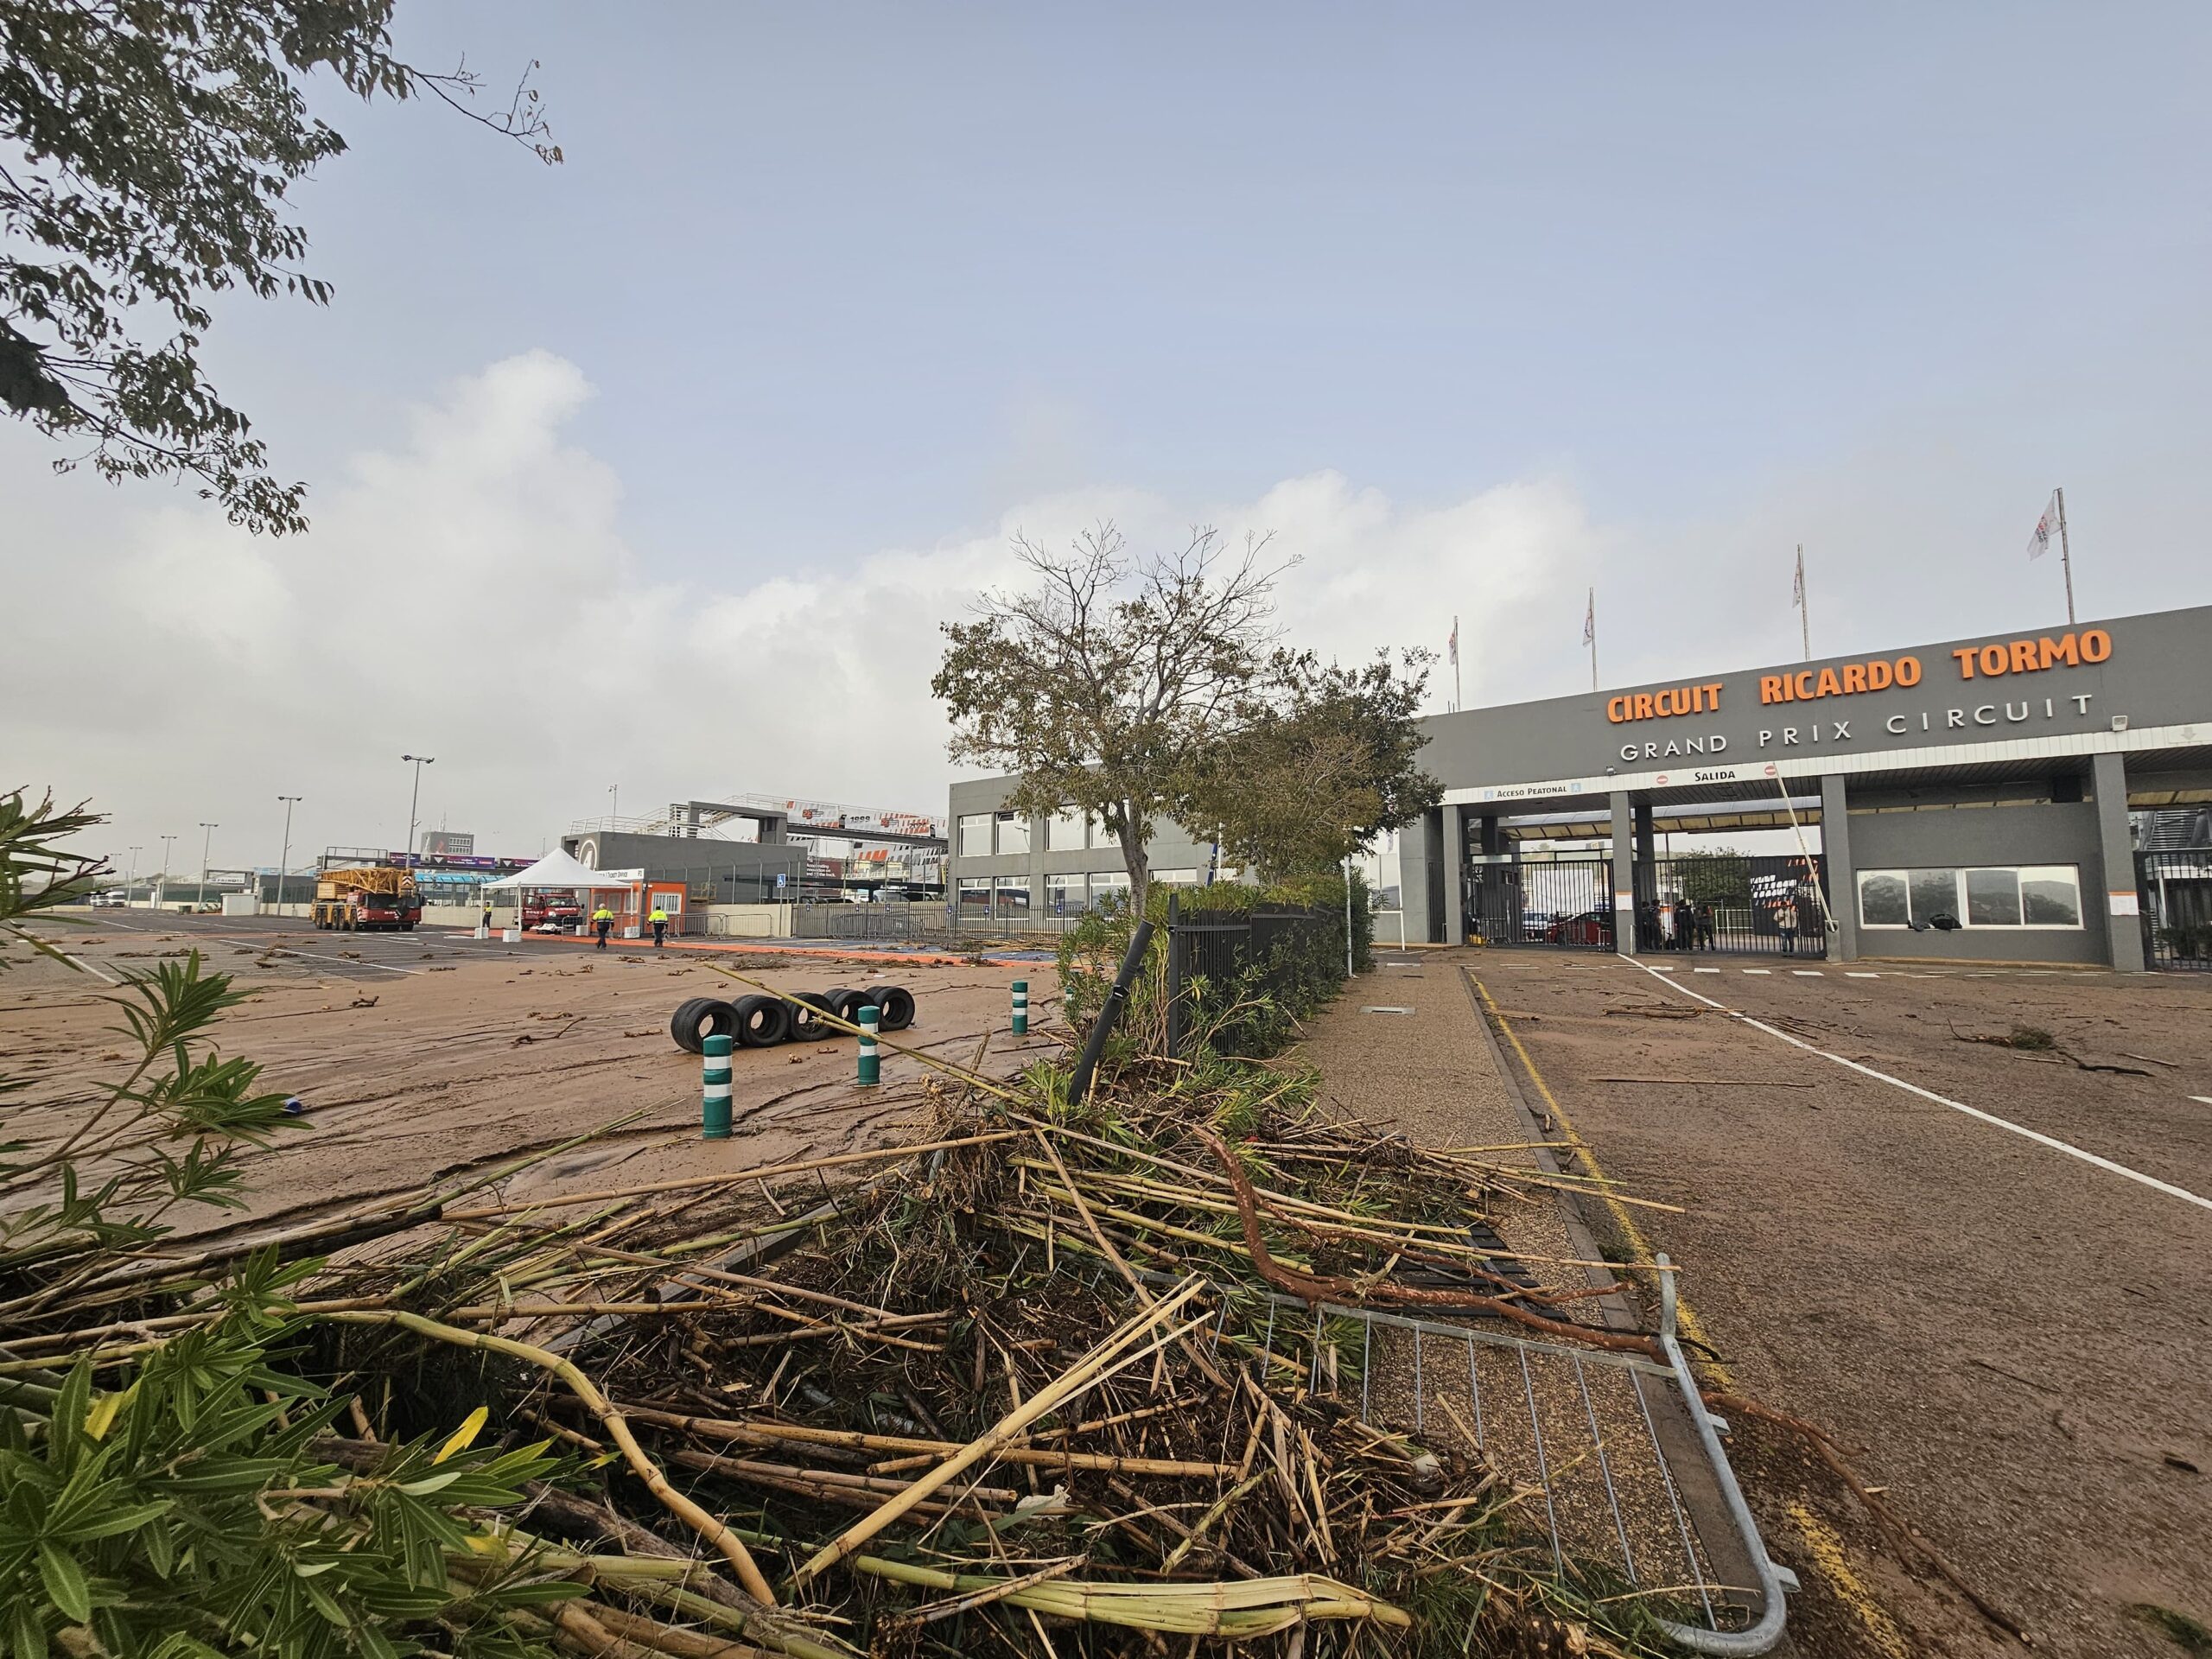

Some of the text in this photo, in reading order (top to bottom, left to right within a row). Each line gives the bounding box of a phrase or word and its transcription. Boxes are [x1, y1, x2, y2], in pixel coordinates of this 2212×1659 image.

[1607, 629, 2111, 722] CIRCUIT RICARDO TORMO
[1620, 694, 2094, 761] GRAND PRIX CIRCUIT
[1694, 770, 1736, 782] SALIDA
